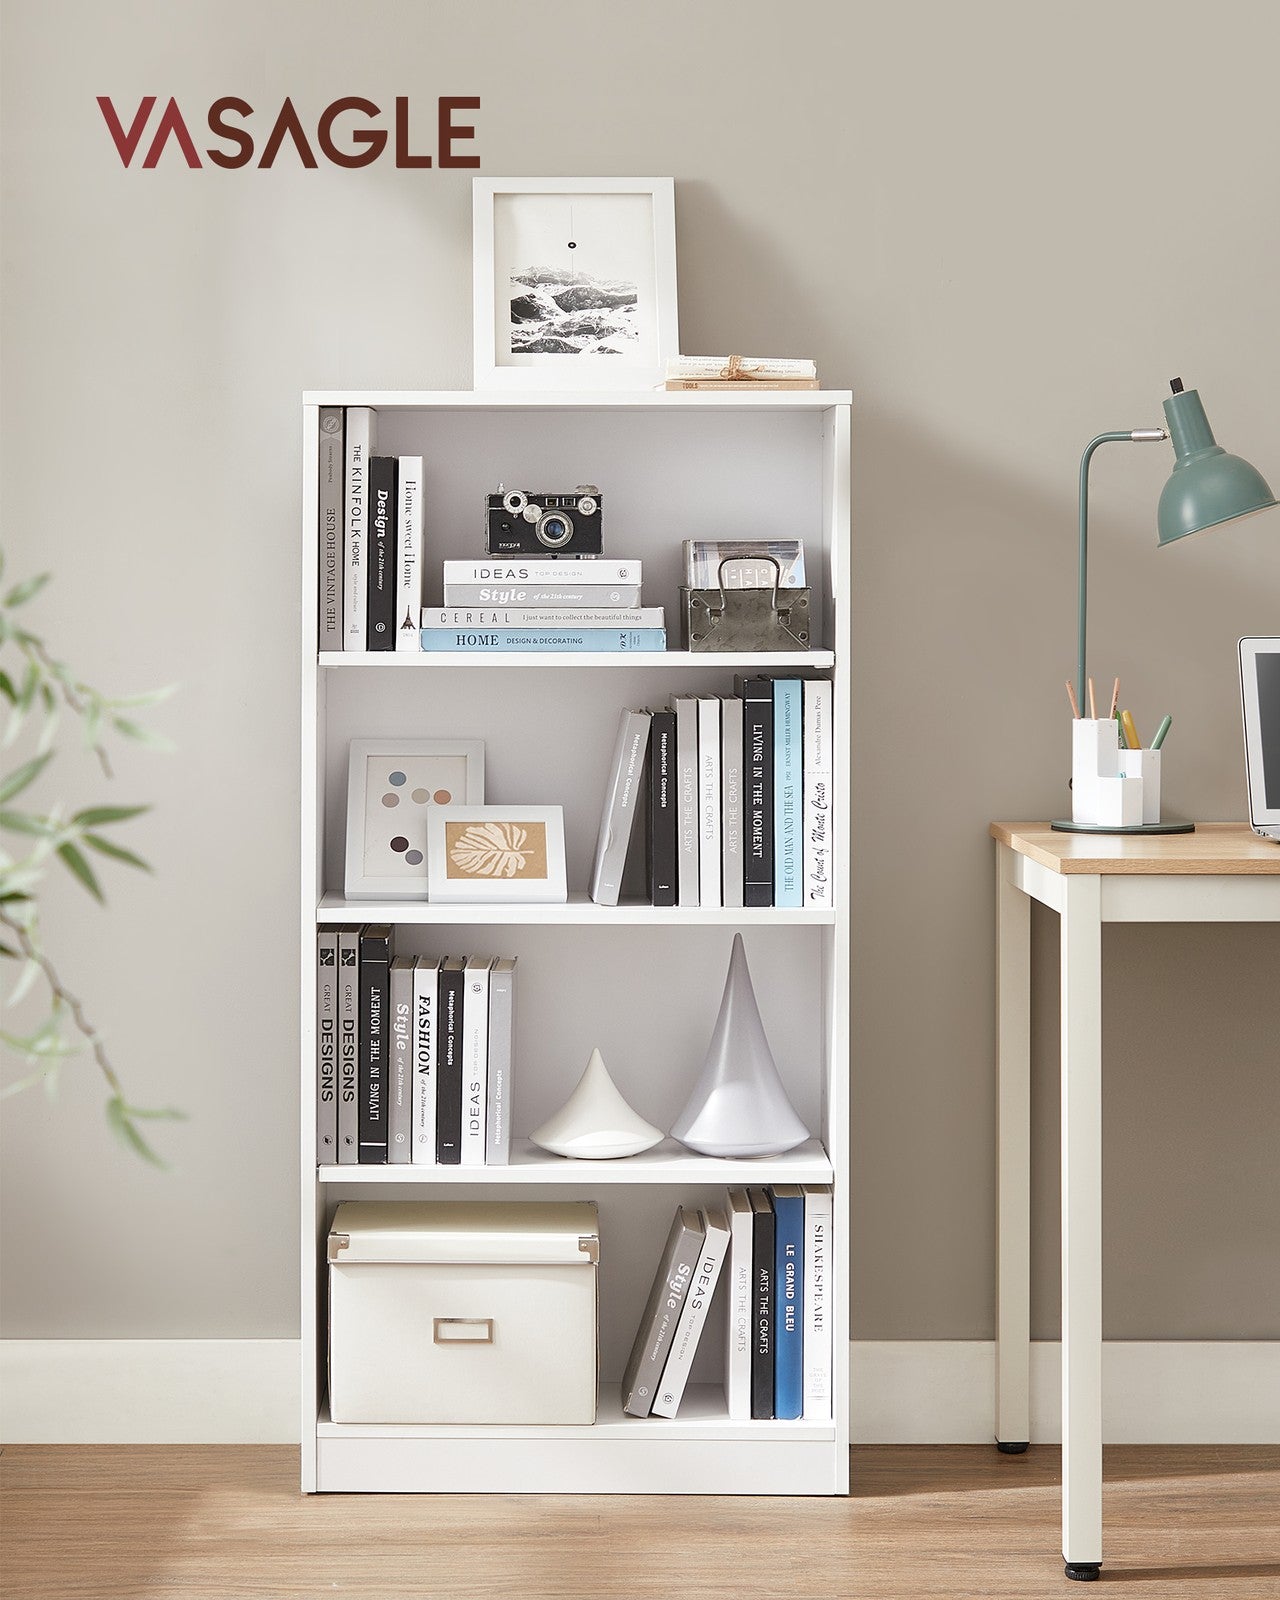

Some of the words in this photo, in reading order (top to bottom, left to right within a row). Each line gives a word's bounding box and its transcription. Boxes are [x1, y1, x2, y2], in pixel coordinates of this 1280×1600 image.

[353, 445, 361, 462] THE
[351, 467, 362, 539] KINFOLK
[404, 480, 416, 516] Home
[374, 490, 388, 538] Design
[326, 508, 336, 549] HOUSE
[404, 519, 414, 549] sweet
[352, 541, 360, 567] HOME
[377, 541, 385, 549] of
[326, 551, 336, 604] VINTAGE
[403, 553, 415, 590] Home
[474, 568, 529, 579] IDEAS
[479, 589, 527, 604] Style
[326, 608, 336, 632] THE
[440, 613, 510, 623] CEREAL
[525, 614, 538, 624] just
[562, 613, 582, 621] collect
[583, 613, 592, 621] the
[593, 613, 622, 621] beautiful
[622, 613, 642, 623] things
[456, 634, 500, 645] HOME
[627, 733, 641, 776] Metaphorical
[659, 732, 668, 776] Metaphorical
[753, 724, 763, 761] LIVING
[705, 755, 713, 778] ARTS
[753, 766, 763, 778] IN
[621, 778, 633, 808] Concepts
[659, 778, 668, 808] Concepts
[683, 768, 692, 803] CRAFTS
[705, 783, 713, 801] THE
[728, 768, 737, 803] CRAFTS
[753, 782, 763, 805] THE
[784, 785, 793, 799] SEA
[811, 783, 827, 810] Cristo
[684, 806, 692, 825] THE
[729, 807, 737, 826] THE
[784, 800, 794, 816] THE
[705, 805, 713, 840] CRAFTS
[753, 810, 763, 859] MOMENT
[784, 817, 794, 835] AND
[811, 813, 825, 842] Monte
[684, 829, 693, 853] ARTS
[729, 830, 737, 854] ARTS
[784, 837, 794, 856] MAN
[812, 848, 829, 856] of
[784, 857, 794, 875] OLD
[810, 858, 827, 882] Count
[784, 876, 794, 892] THE
[810, 885, 825, 900] The
[323, 985, 331, 1013] GREAT
[370, 986, 380, 1035] MOMENT
[447, 990, 455, 1033] Metaphorical
[393, 1003, 409, 1050] Style
[418, 995, 430, 1076] FASHION
[321, 1019, 333, 1102] DESIGNS
[343, 1019, 355, 1103] DESIGNS
[370, 1040, 380, 1062] THE
[397, 1057, 405, 1065] of
[446, 1035, 454, 1066] Concepts
[370, 1067, 380, 1078] IN
[495, 1069, 503, 1100] Concepts
[369, 1083, 380, 1121] LIVING
[470, 1082, 480, 1136] IDEAS
[494, 1102, 502, 1145] Metaphorical
[785, 1244, 795, 1257] LE
[667, 1263, 690, 1309] Style
[691, 1256, 715, 1310] IDEAS
[738, 1267, 747, 1291] ARTS
[759, 1268, 769, 1293] ARTS
[785, 1262, 795, 1299] GRAND
[813, 1224, 824, 1332] SHAKESPEARE
[738, 1295, 746, 1313] THE
[759, 1296, 768, 1315] THE
[688, 1315, 696, 1330] TOP
[785, 1305, 795, 1332] BLEU
[678, 1331, 691, 1360] DESIGN
[738, 1317, 746, 1352] CRAFTS
[759, 1318, 768, 1354] CRAFTS
